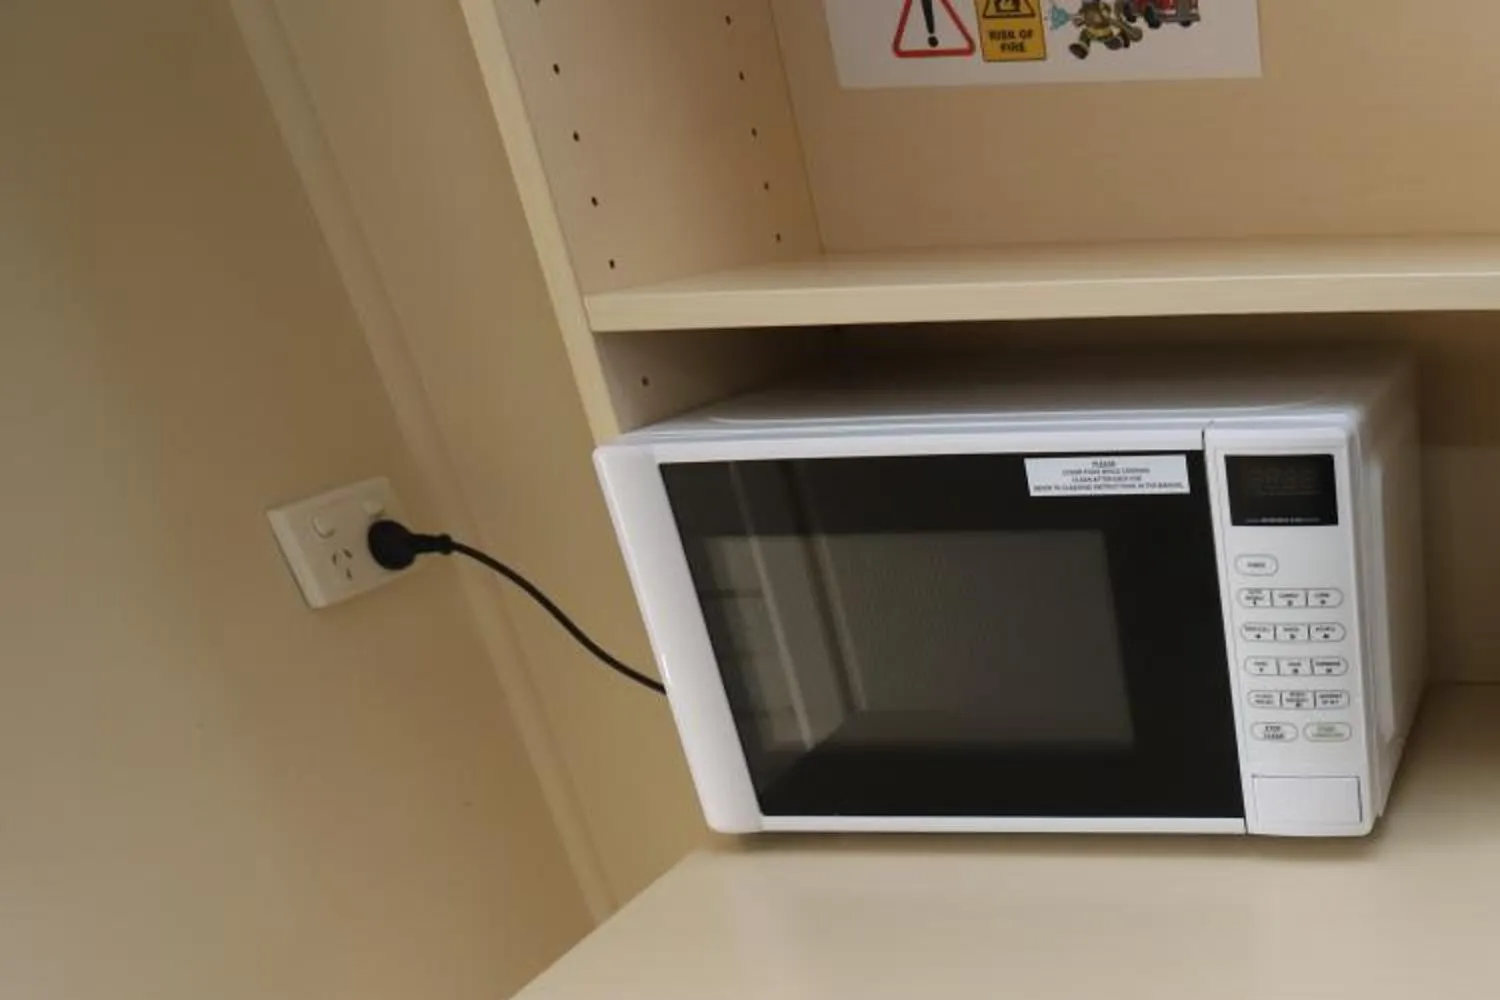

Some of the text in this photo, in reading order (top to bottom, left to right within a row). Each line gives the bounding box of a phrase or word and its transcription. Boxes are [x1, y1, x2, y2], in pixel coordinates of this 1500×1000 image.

[988, 28, 1033, 40] RISK OF
[1000, 41, 1026, 52] FIRE
